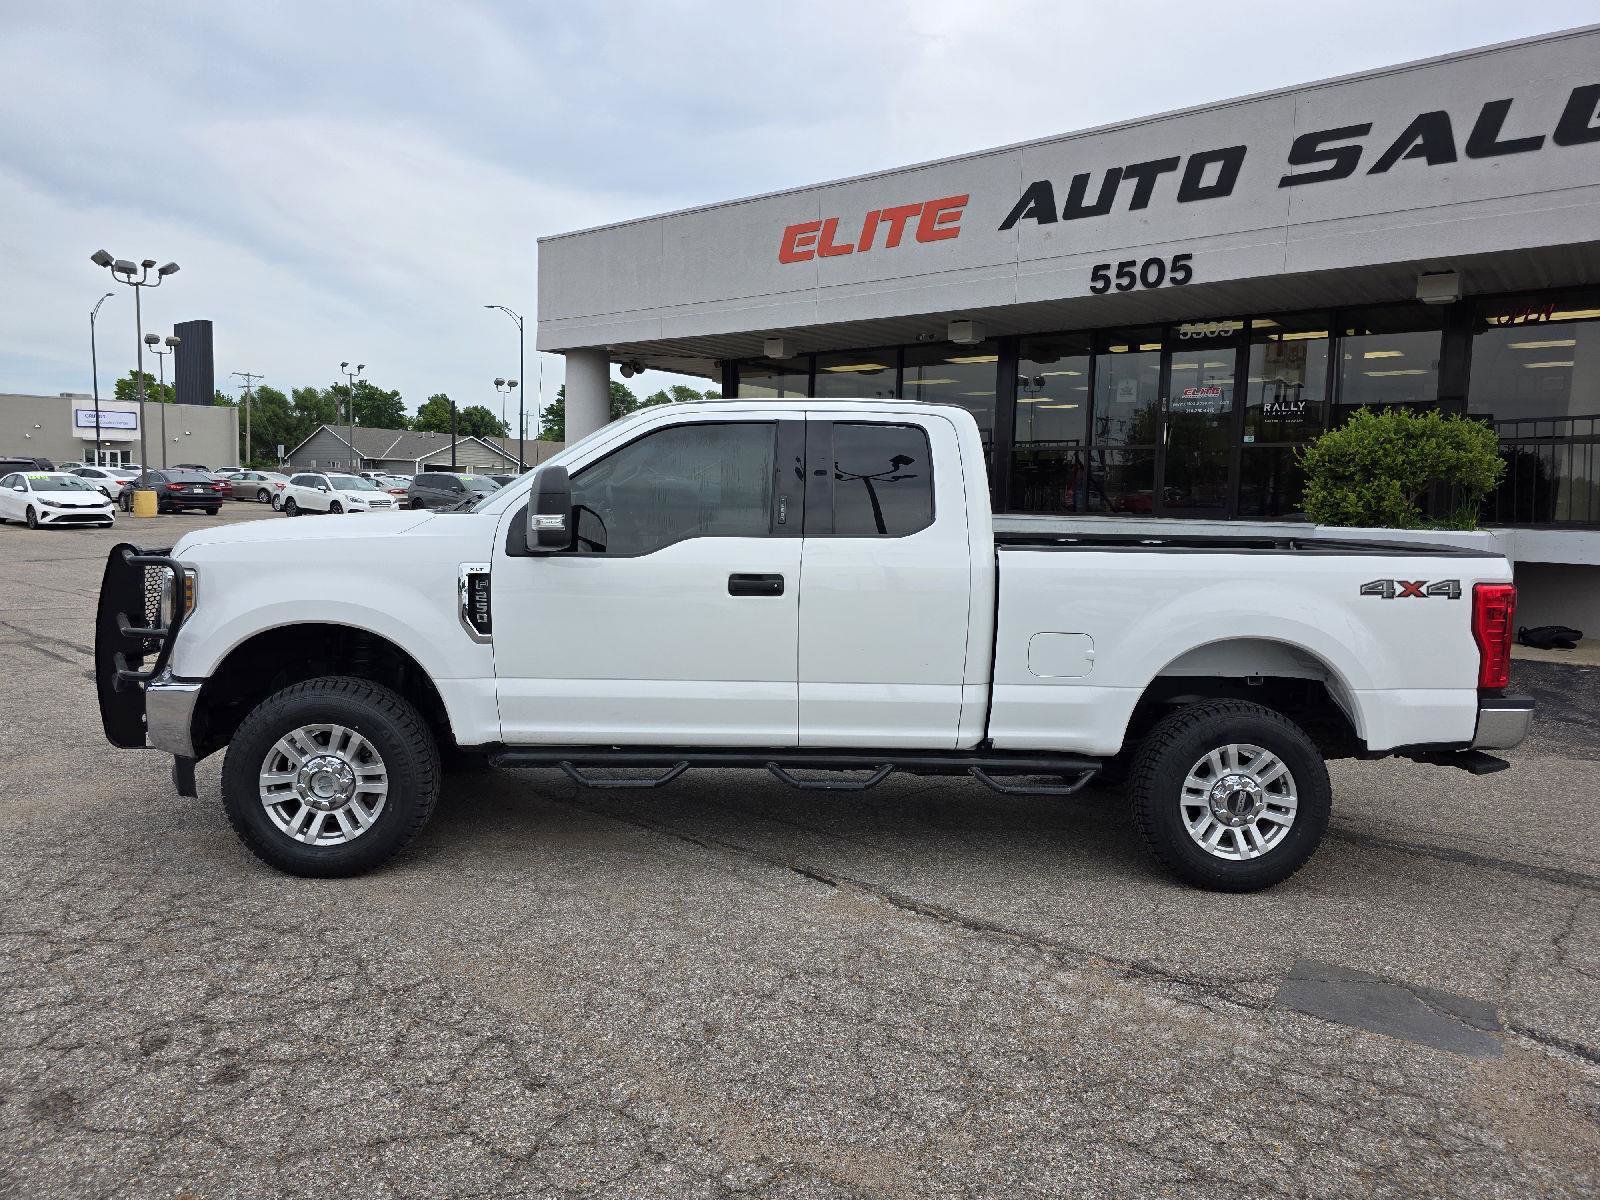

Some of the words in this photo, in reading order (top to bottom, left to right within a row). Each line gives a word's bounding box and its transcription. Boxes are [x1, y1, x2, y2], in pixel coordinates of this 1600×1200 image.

[778, 193, 970, 265] ELITE
[998, 144, 1247, 231] AUTO
[1089, 253, 1193, 295] 5505
[1179, 320, 1234, 340] 5505
[1182, 386, 1222, 398] ELITE
[1263, 401, 1306, 412] RALLY
[1360, 579, 1462, 600] 4X4
